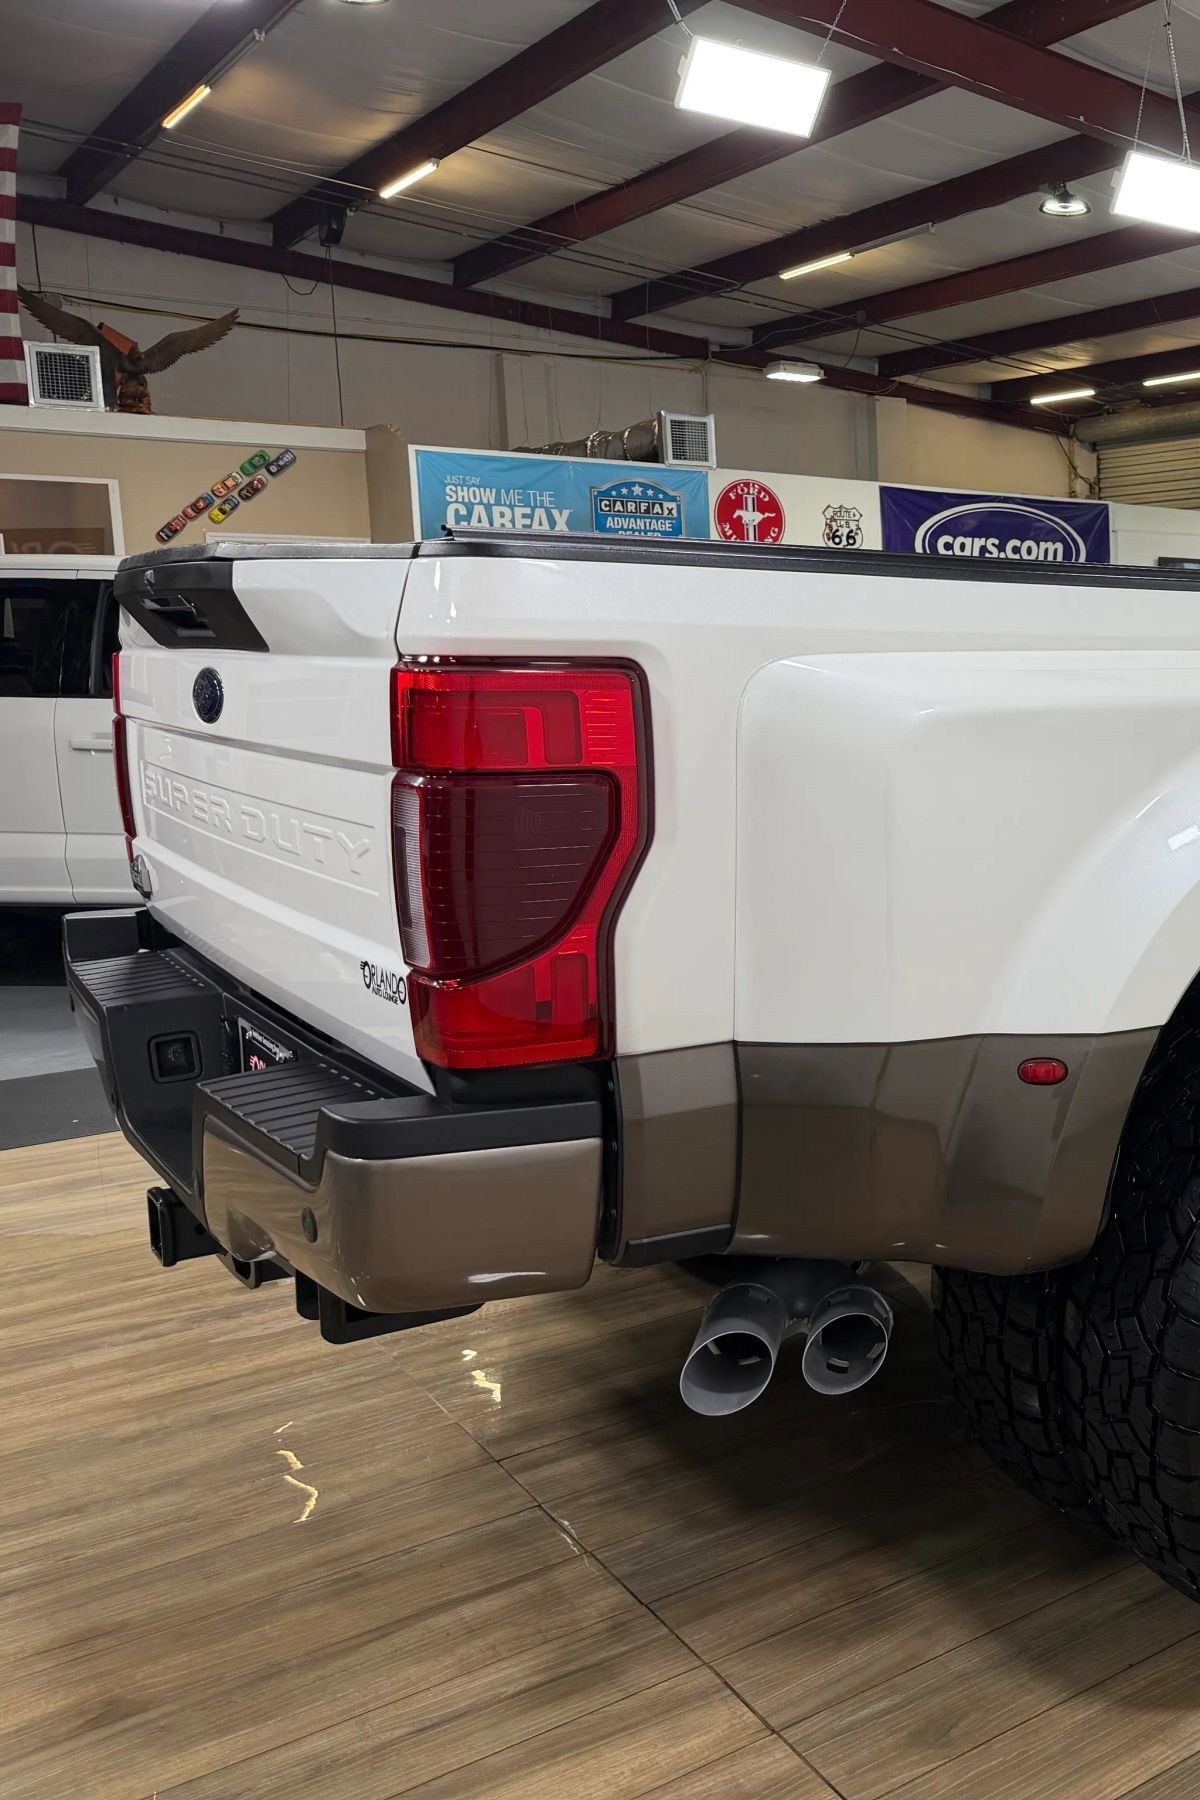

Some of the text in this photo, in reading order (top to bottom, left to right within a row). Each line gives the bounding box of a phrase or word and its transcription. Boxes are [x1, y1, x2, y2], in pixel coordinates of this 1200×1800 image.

[444, 475, 480, 486] JUST SAY
[445, 485, 555, 508] SHOW ME THE
[728, 482, 769, 502] FORD
[446, 503, 571, 532] CARFAX
[600, 499, 675, 517] CARFAX
[832, 510, 852, 518] ROUTE
[606, 516, 673, 532] ADVANTAGE
[831, 528, 856, 547] 66
[936, 535, 1064, 562] cars.com
[144, 771, 371, 876] SUPER DUTY
[360, 960, 407, 1005] ORLANDO
